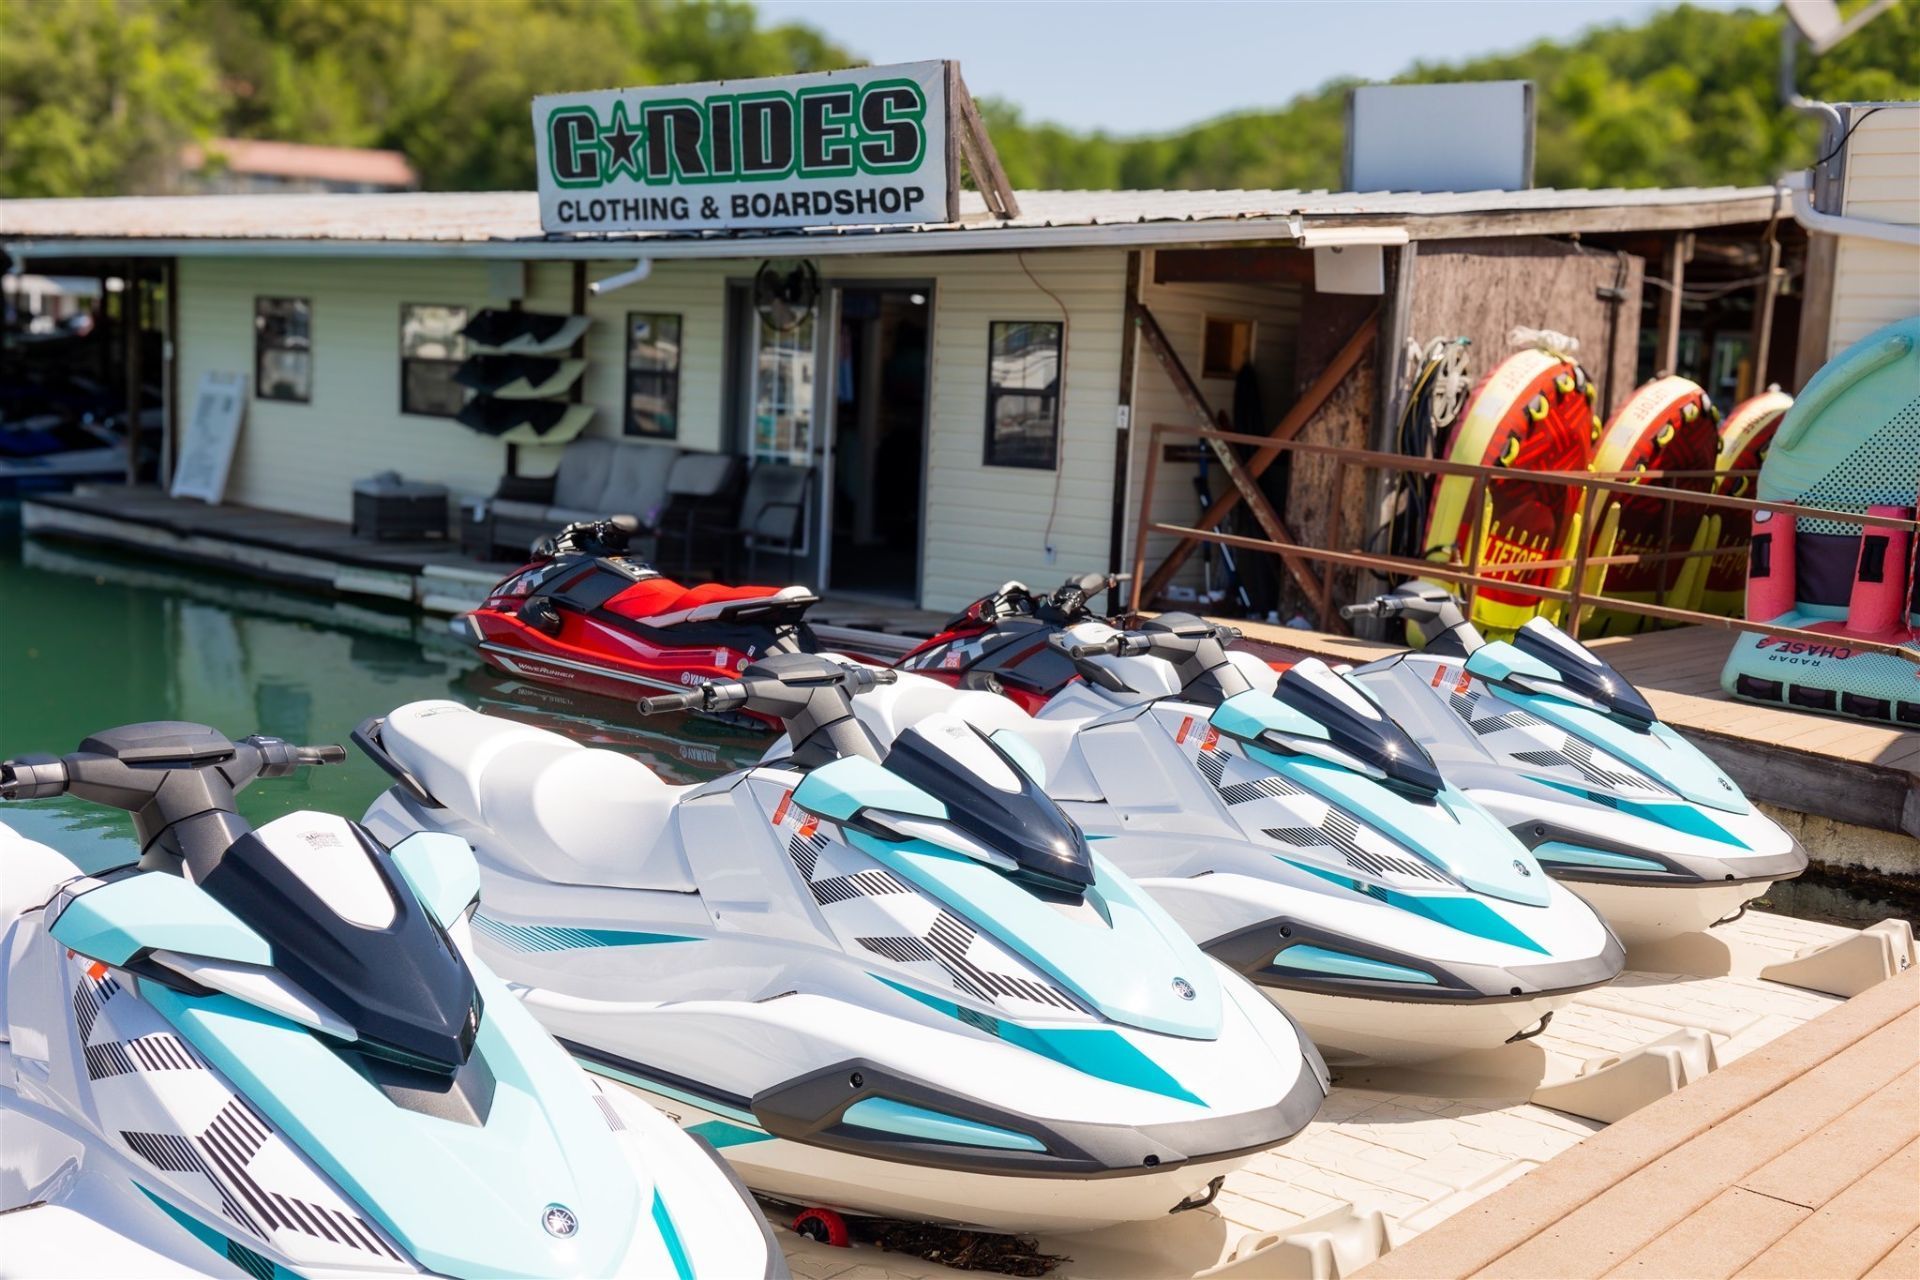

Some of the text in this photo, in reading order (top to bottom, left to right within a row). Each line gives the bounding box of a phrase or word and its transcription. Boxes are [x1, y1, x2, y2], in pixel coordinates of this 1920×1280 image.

[557, 186, 925, 223] CLOTHING & BOARDSHOP
[1755, 637, 1852, 661] CHASE 3
[1768, 654, 1821, 667] RADAR
